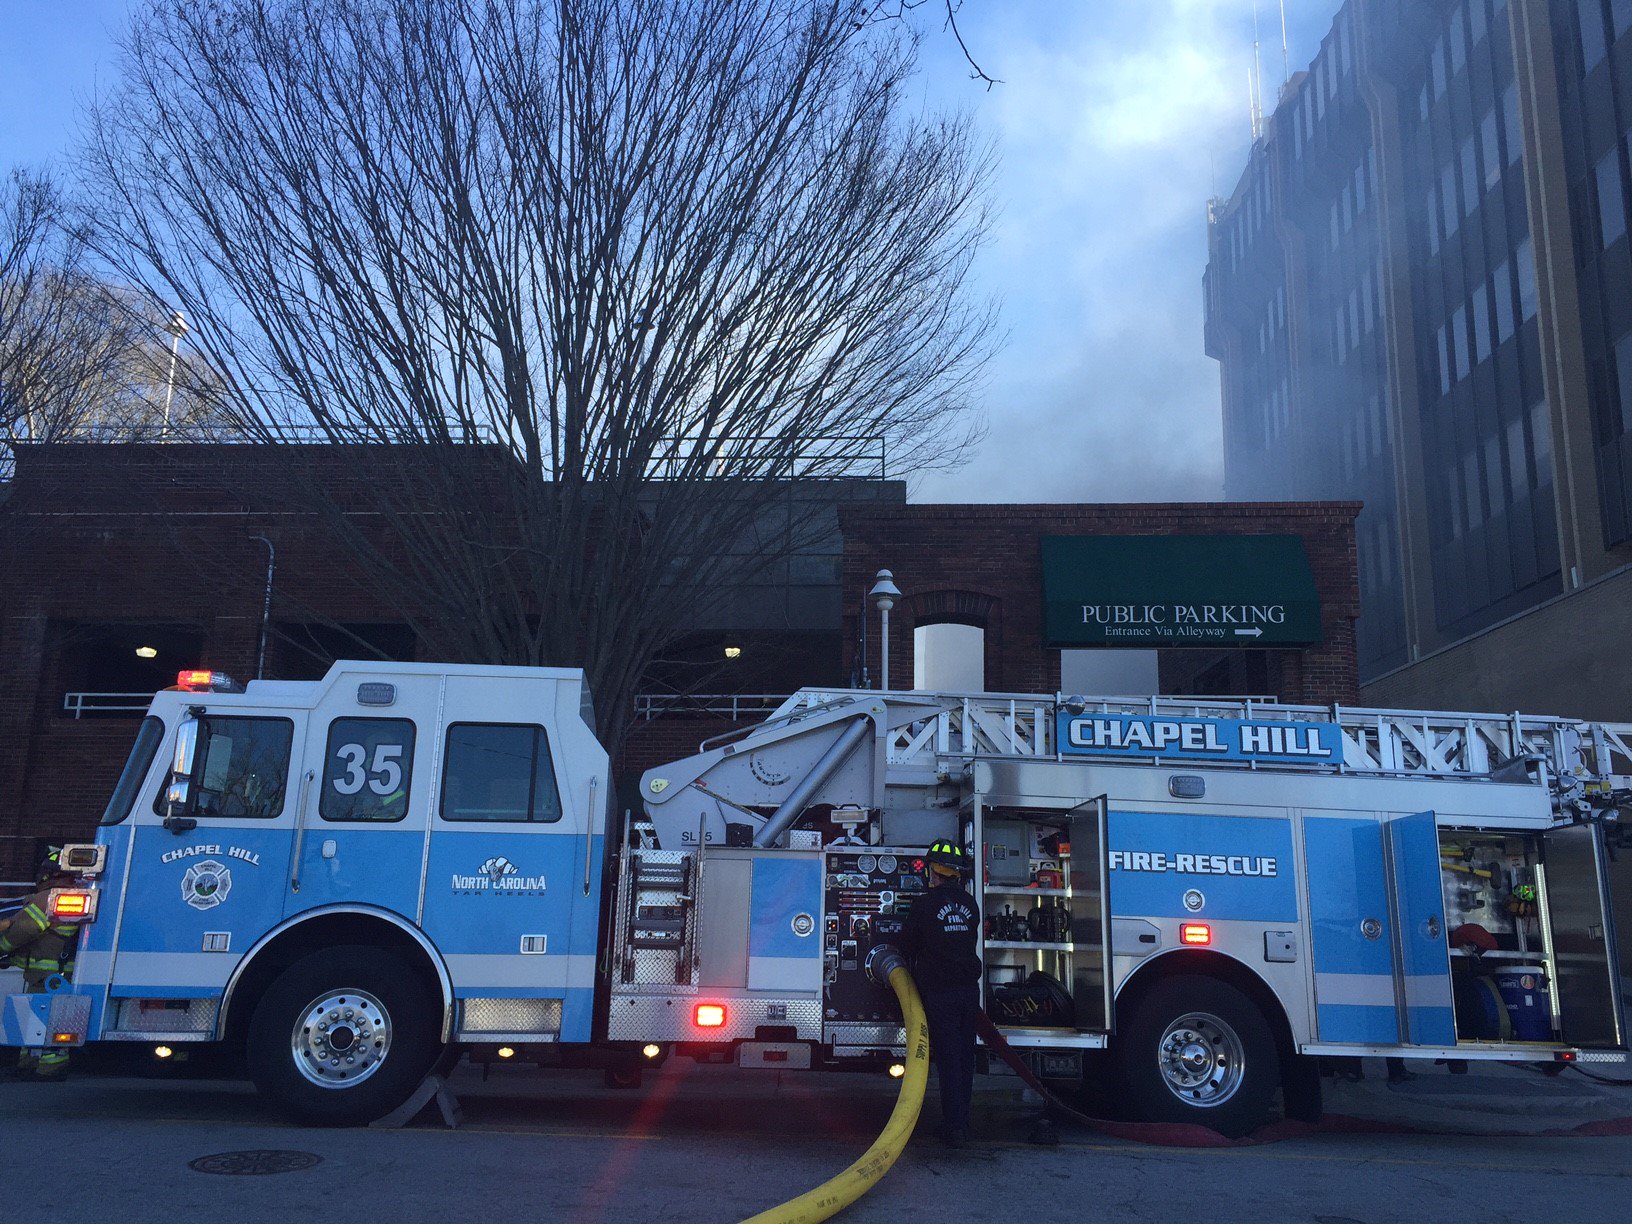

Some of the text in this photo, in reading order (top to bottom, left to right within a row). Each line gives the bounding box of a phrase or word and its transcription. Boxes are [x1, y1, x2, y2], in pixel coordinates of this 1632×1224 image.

[1081, 605, 1286, 624] PUBLIC PARKING
[1104, 626, 1227, 639] Entrance Via Alleyway
[1068, 718, 1332, 756] CHAPEL HILL
[332, 743, 403, 796] 35
[681, 831, 697, 842] SL
[161, 844, 260, 867] CHAPEL HILL
[1108, 850, 1278, 877] FIRE-RESCUE
[451, 874, 547, 890] NORTH CAROLINA
